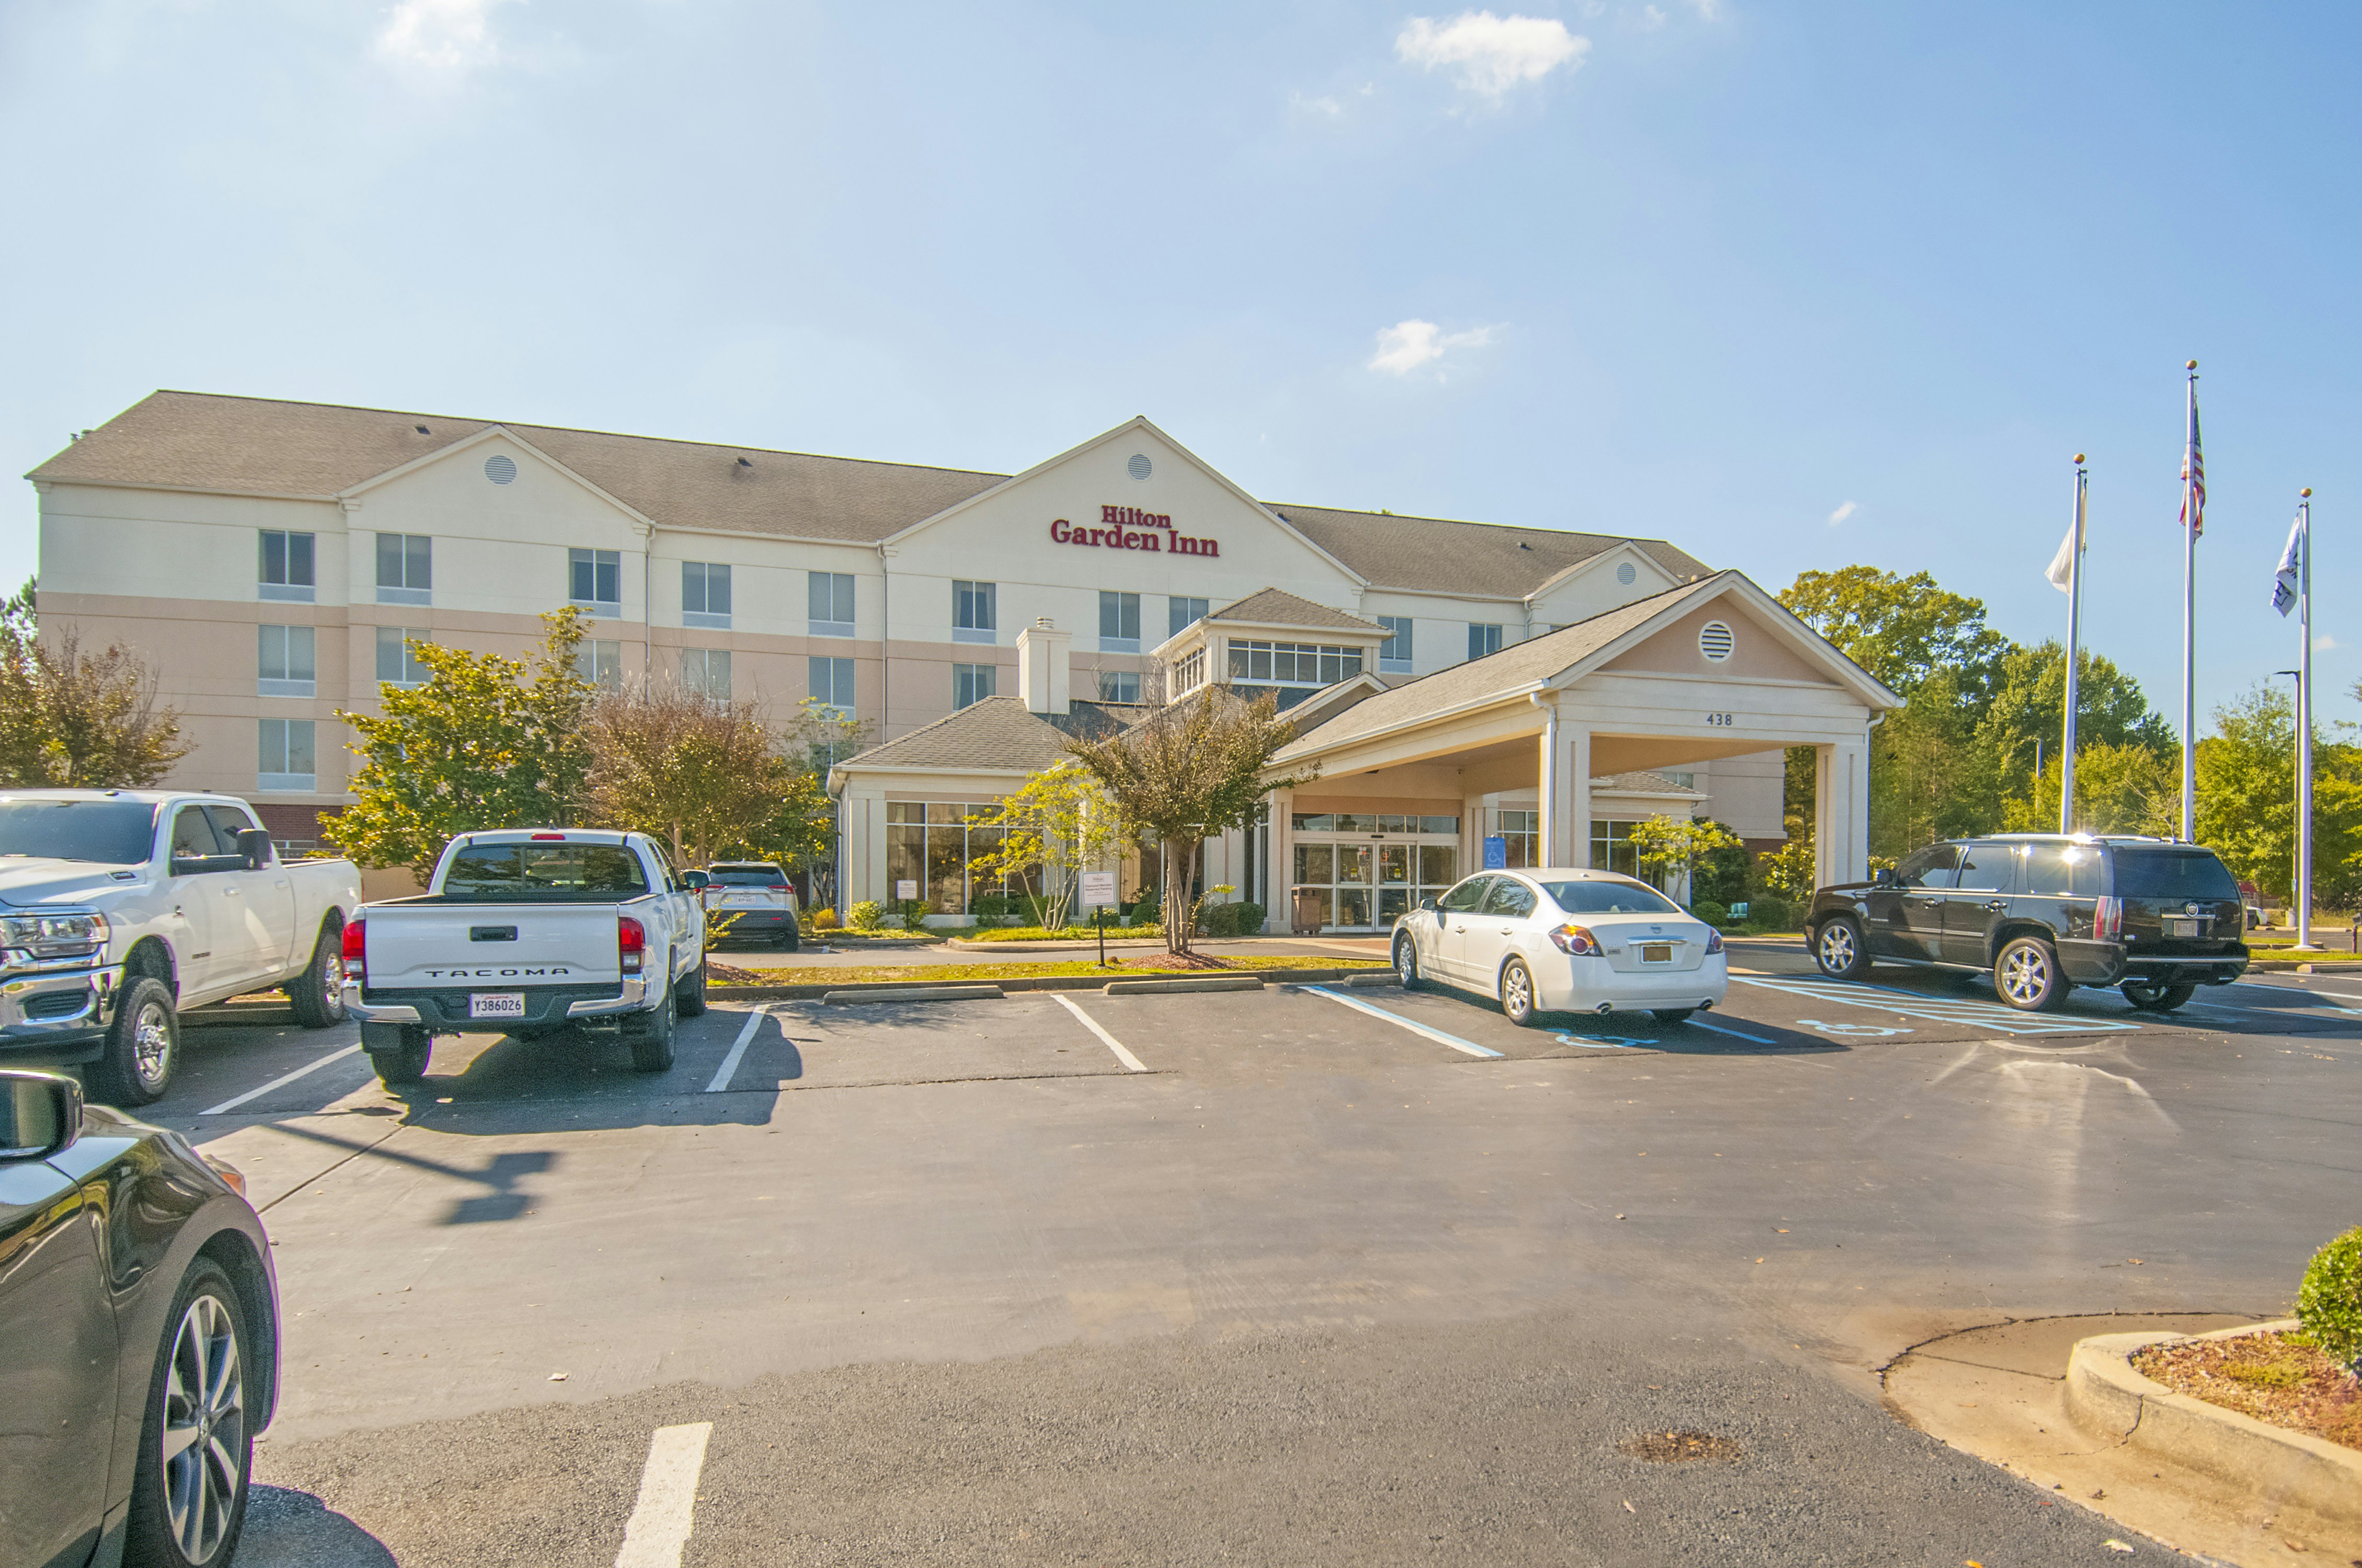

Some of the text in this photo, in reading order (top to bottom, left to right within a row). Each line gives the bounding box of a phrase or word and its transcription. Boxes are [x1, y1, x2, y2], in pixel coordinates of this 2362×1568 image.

[1102, 505, 1172, 528] Hilton
[1051, 519, 1220, 557] Garden Inn
[1707, 713, 1732, 726] 438
[425, 968, 569, 977] TACOMA
[474, 1000, 521, 1011] Y386026
